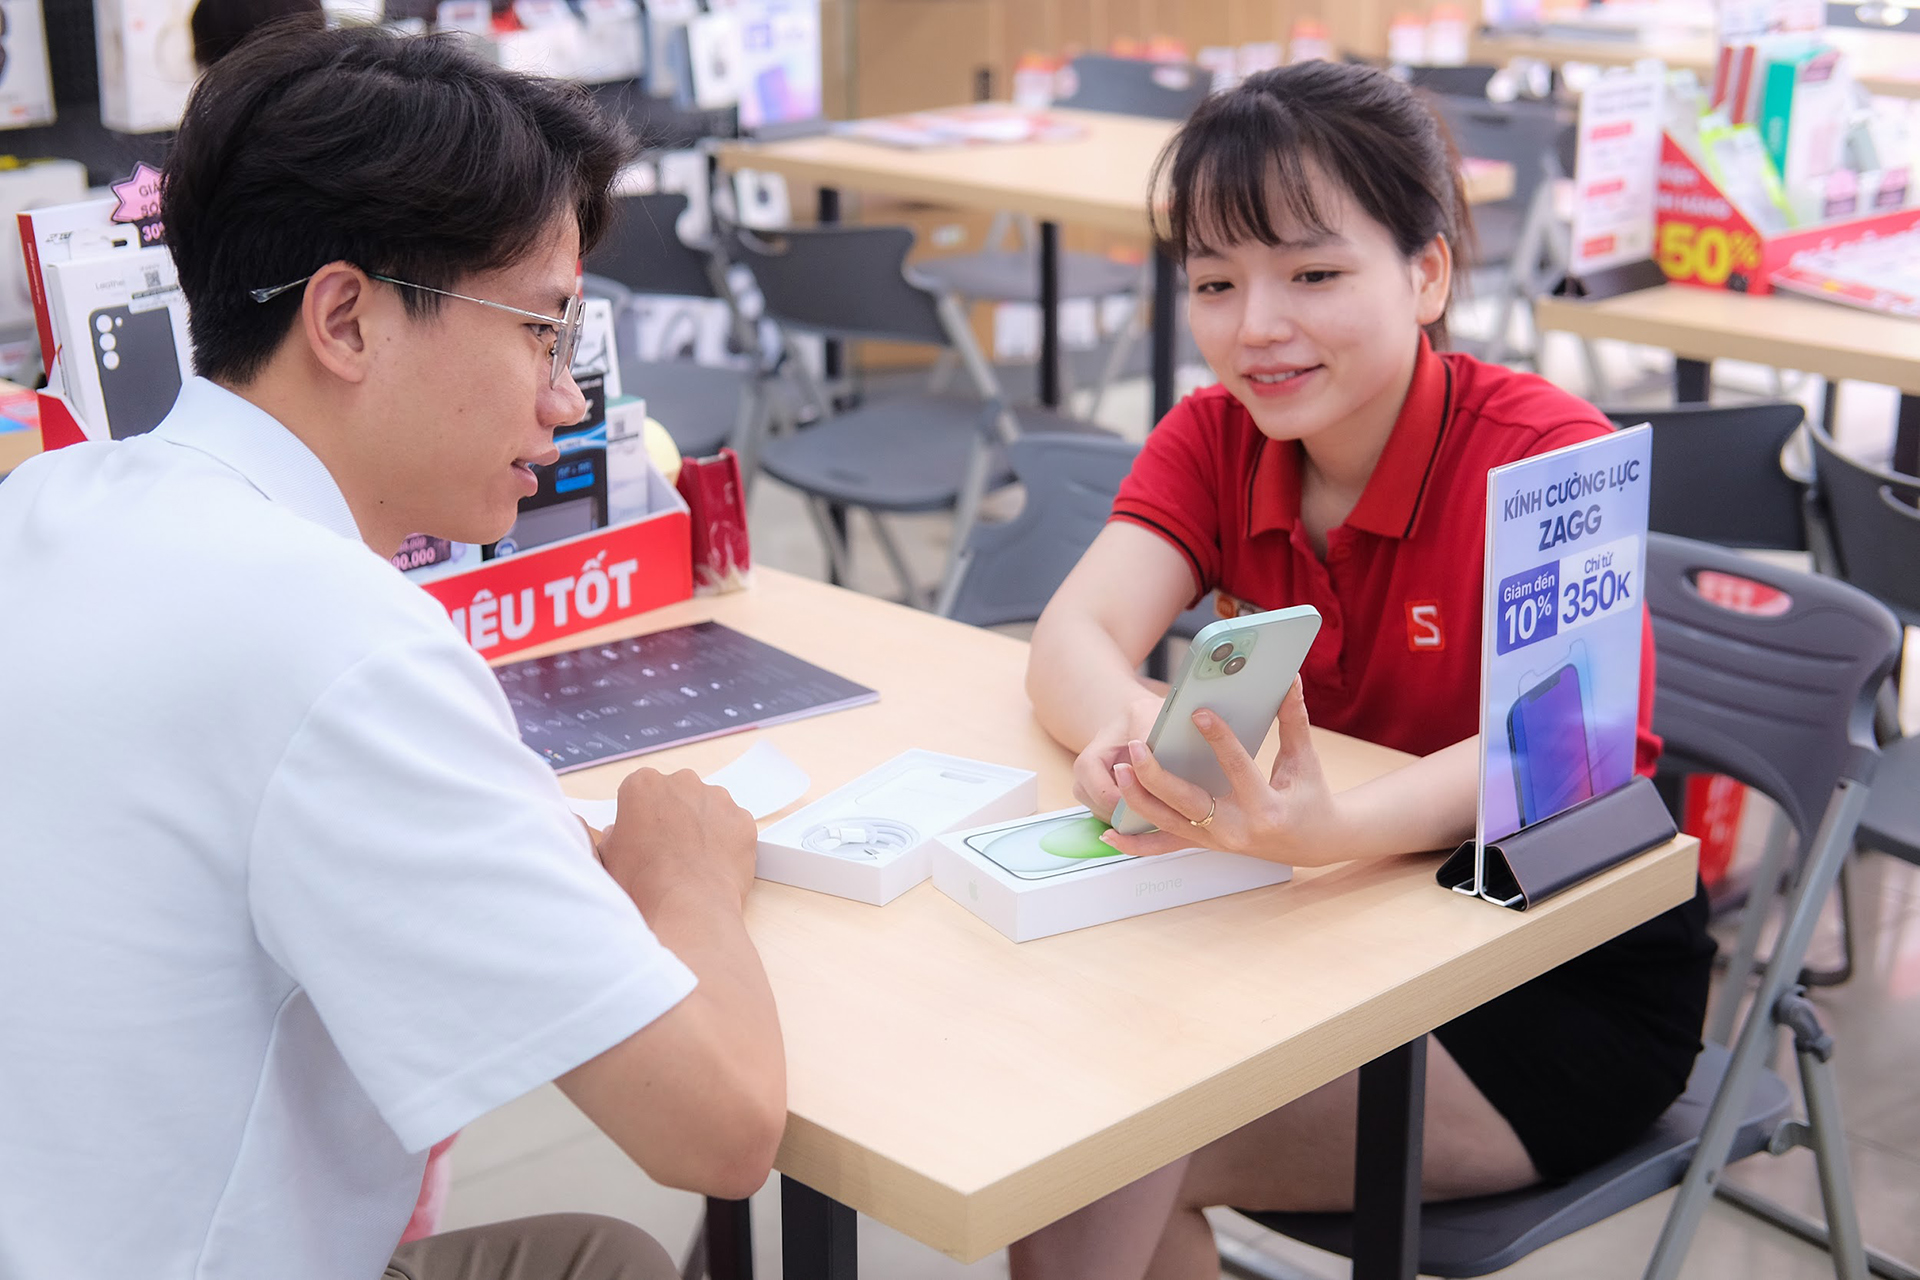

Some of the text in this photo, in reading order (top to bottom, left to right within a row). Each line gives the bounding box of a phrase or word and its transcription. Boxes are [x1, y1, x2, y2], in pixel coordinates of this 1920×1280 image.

[1503, 459, 1640, 522] KÍNH CƯỜNG LỰC
[1538, 503, 1602, 552] ZAGG
[1503, 570, 1555, 603] Giảm đến
[1584, 550, 1614, 575] Chỉ từ
[451, 549, 639, 650] IÊU TỐT
[1504, 591, 1553, 645] 10%
[1562, 569, 1631, 625] 350K
[1135, 877, 1183, 898] iPhone
